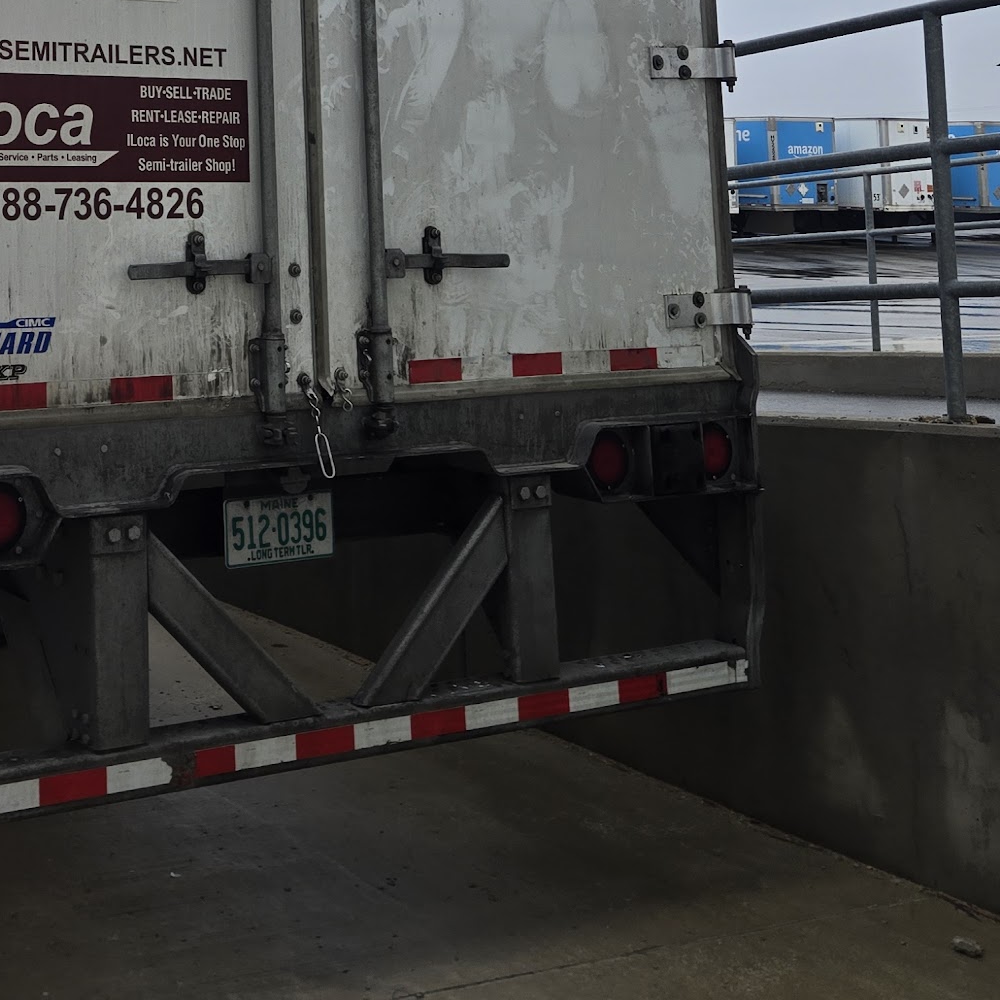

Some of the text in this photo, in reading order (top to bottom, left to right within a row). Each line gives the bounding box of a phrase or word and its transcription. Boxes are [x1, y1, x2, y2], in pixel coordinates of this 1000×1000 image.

[159, 134, 169, 148] is
[171, 134, 196, 149] Your
[198, 134, 220, 149] One
[223, 134, 246, 152] Stop
[787, 144, 823, 155] amazon
[37, 152, 59, 163] Parts
[66, 153, 97, 164] Leasing
[138, 157, 236, 175] Semi-trailer Shop!
[15, 318, 50, 328] CIMC
[261, 498, 298, 511] MAINE
[251, 549, 272, 561] LONG
